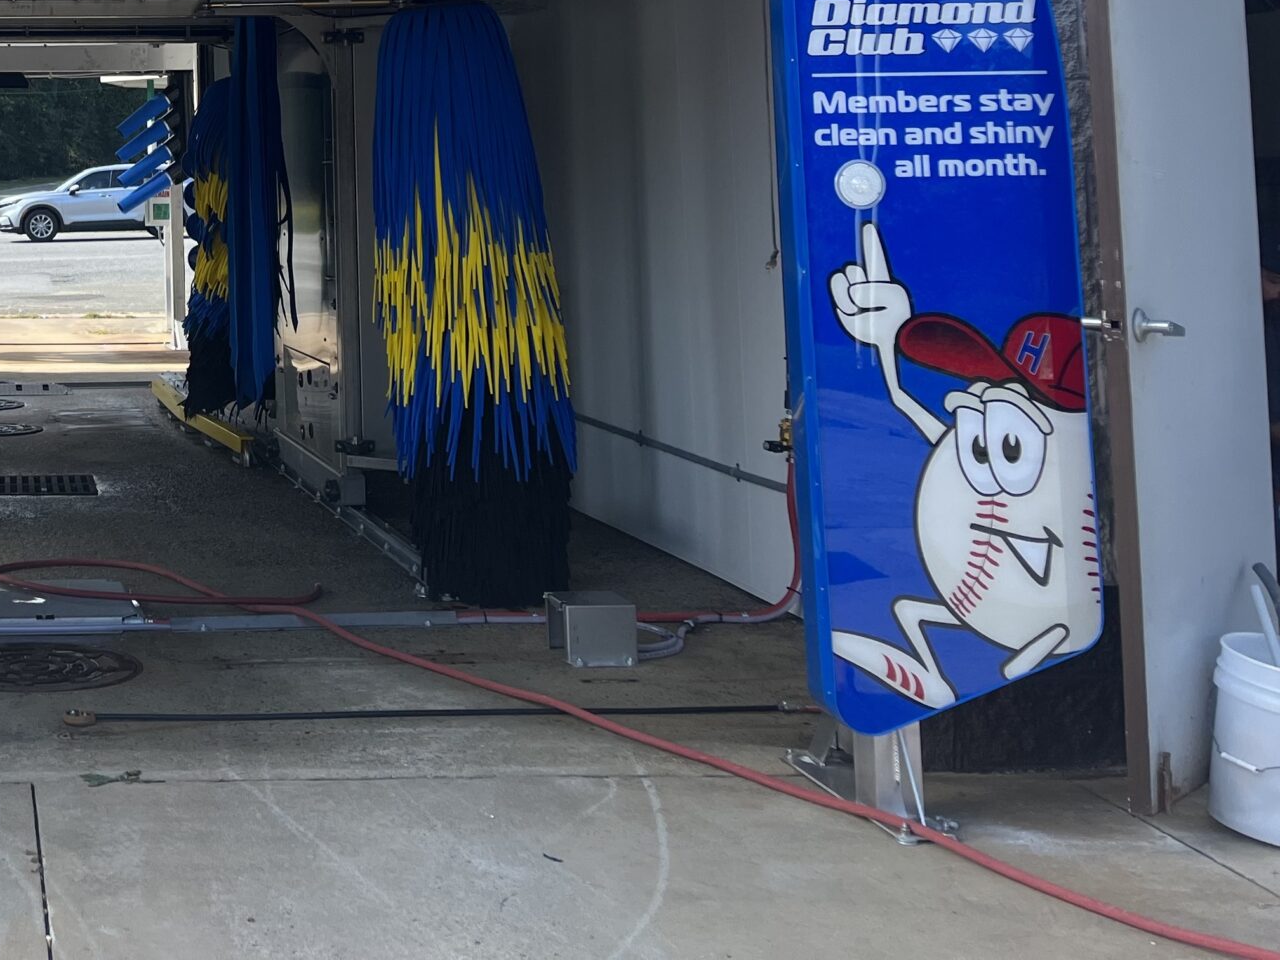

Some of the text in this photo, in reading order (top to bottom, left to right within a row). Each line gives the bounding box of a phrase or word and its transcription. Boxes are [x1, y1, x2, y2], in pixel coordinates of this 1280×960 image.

[807, 27, 926, 56] Club
[813, 88, 1055, 116] Members stay
[814, 121, 1054, 148] clean and shiny
[894, 153, 1047, 177] all month.
[1016, 330, 1051, 376] H
